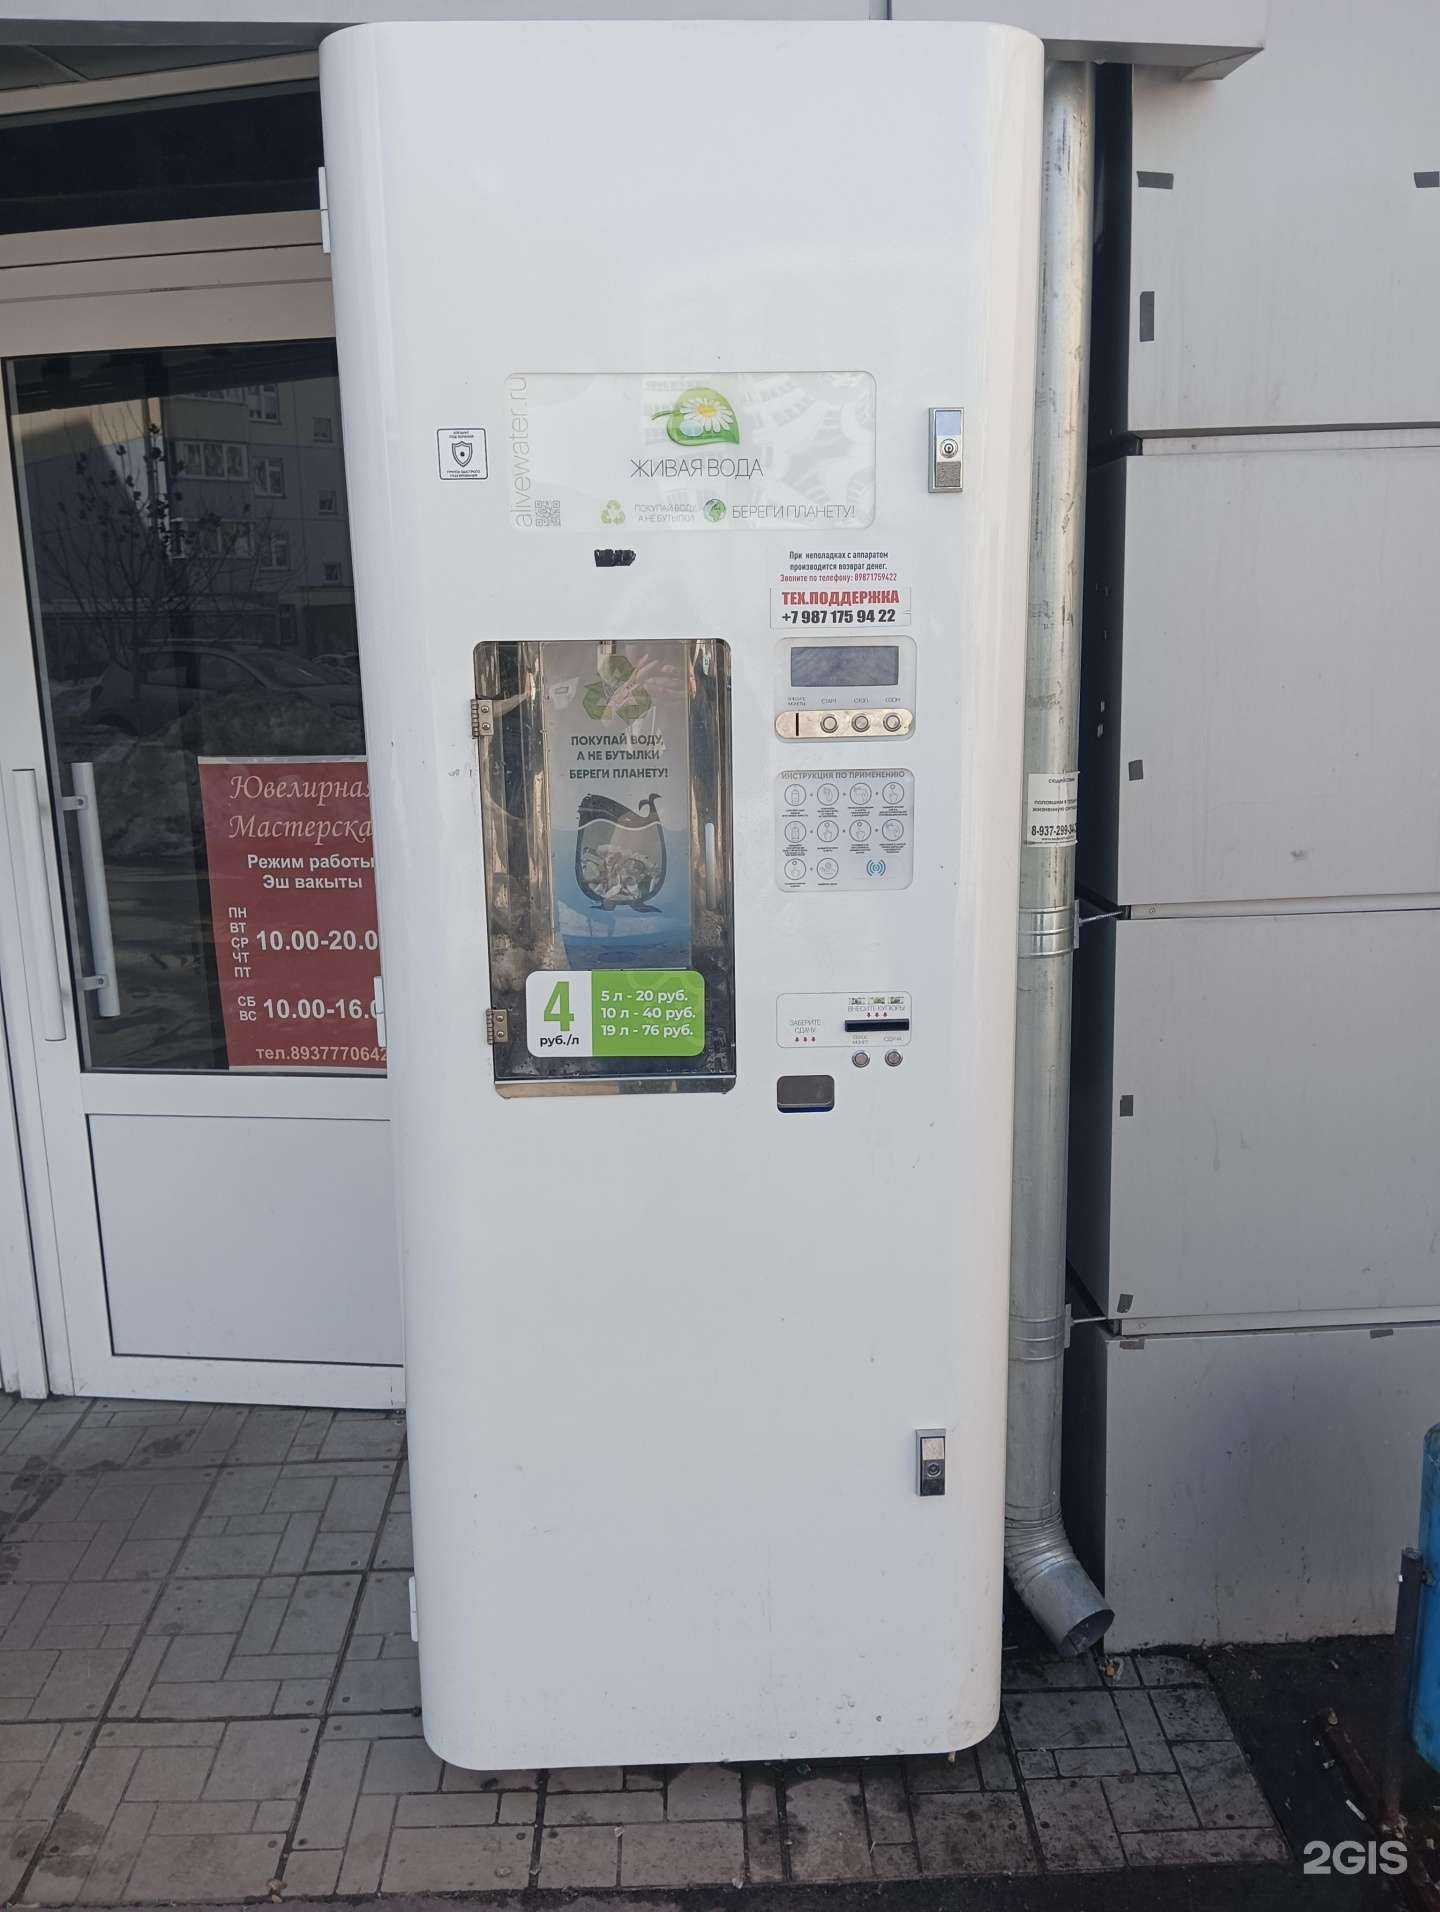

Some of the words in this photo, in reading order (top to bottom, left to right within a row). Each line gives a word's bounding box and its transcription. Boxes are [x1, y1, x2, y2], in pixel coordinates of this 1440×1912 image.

[509, 376, 532, 528] alivewater.ru
[630, 459, 703, 478] ЖИВАЯ
[707, 458, 764, 480] ВОДА
[731, 504, 784, 520] БЕРЕГИ
[786, 504, 856, 520] ПЛАНЕТУ!
[789, 551, 802, 560] При
[805, 551, 845, 560] неполадках
[852, 551, 888, 560] аппаратом
[790, 563, 837, 572] производится
[838, 562, 864, 571] возврат
[780, 574, 808, 582] Звоните
[819, 573, 853, 583] телефону:
[854, 572, 897, 581] 89871759422
[782, 590, 900, 607] ТЕХ.ПОДДЕРЖКА
[782, 610, 799, 624] +7
[801, 610, 828, 624] 987
[830, 610, 853, 624] 175
[856, 609, 876, 623] 94
[878, 608, 896, 622] 22
[570, 733, 627, 746] ПОКУПАЙ
[630, 734, 664, 746] ВОДУ,
[577, 751, 585, 760] А
[588, 751, 602, 760] НЕ
[605, 750, 660, 760] БУТЫЛКИ
[569, 768, 610, 779] БЕРЕГИ
[613, 767, 669, 779] ПЛАНЕТУ!
[781, 772, 834, 780] ИНСТРУКЦИЯ
[835, 771, 847, 779] ПО
[849, 770, 905, 779] ПРИМЕНЕНИЮ
[247, 853, 304, 869] Режим
[310, 853, 375, 871] работы
[262, 874, 290, 889] Эш
[296, 875, 363, 889] вакыты
[228, 906, 247, 919] ПН
[230, 922, 246, 934] ВТ
[231, 937, 249, 950] СР
[232, 952, 250, 964] ЧТ
[234, 966, 252, 978] ПТ
[238, 994, 256, 1007] СБ
[600, 990, 610, 1002] 5
[612, 992, 623, 1002] л
[636, 990, 654, 1002] 20
[657, 989, 688, 1004] руб.
[544, 981, 575, 1031] 4
[239, 1009, 258, 1021] ВС
[600, 1007, 617, 1019] 10
[619, 1009, 630, 1019] л
[642, 1007, 662, 1019] 40
[665, 1006, 696, 1021] руб.
[600, 1024, 616, 1036] 19
[619, 1026, 630, 1036] л
[642, 1024, 660, 1036] 76
[663, 1024, 693, 1038] руб.
[539, 1033, 580, 1047] руб./л
